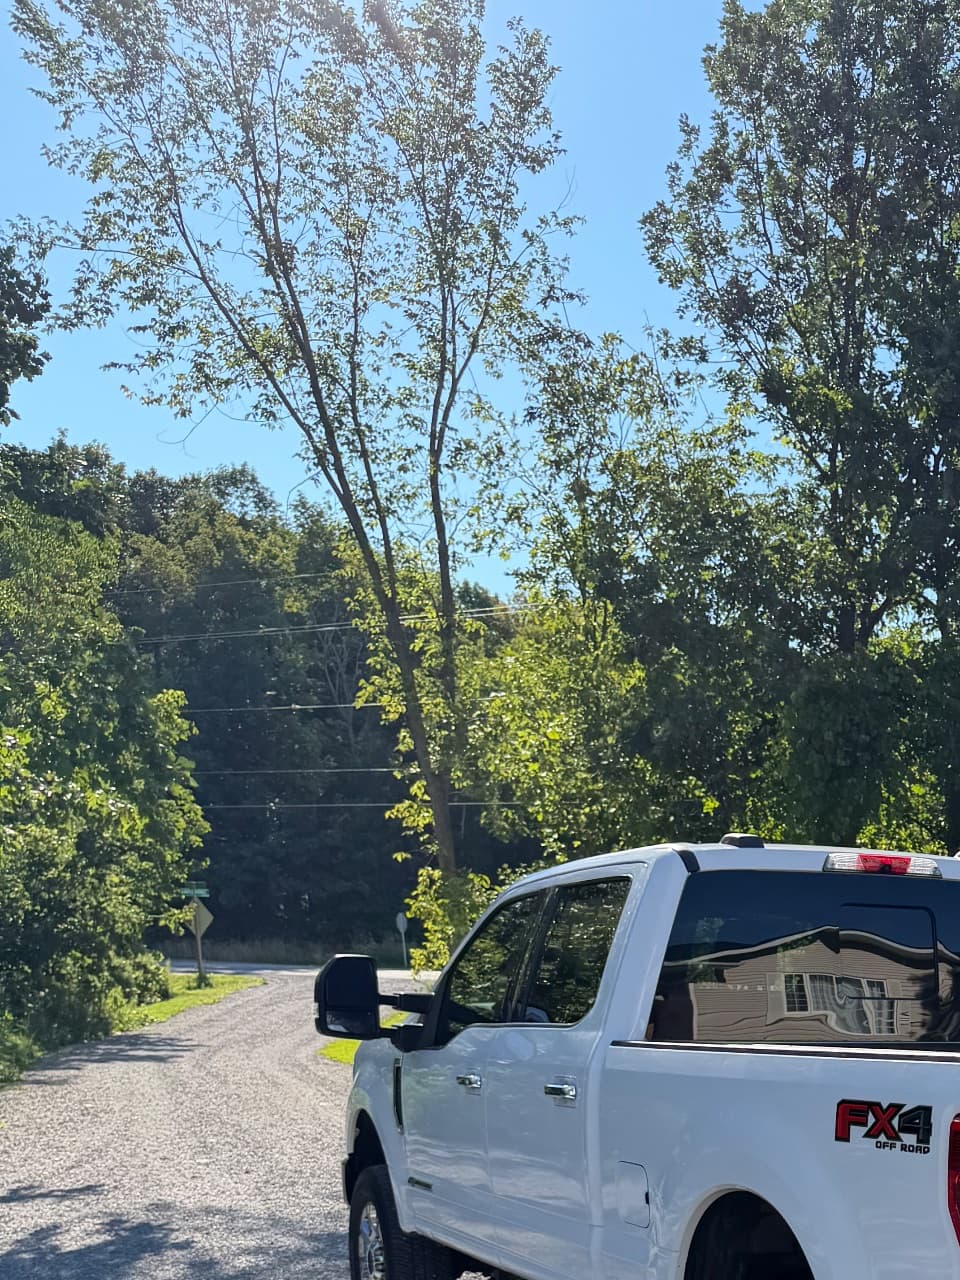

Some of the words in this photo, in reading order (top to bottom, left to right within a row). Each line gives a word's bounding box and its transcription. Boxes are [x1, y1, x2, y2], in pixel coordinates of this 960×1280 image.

[835, 1099, 933, 1145] FX4
[875, 1140, 896, 1151] OFF
[900, 1143, 930, 1155] ROAD
